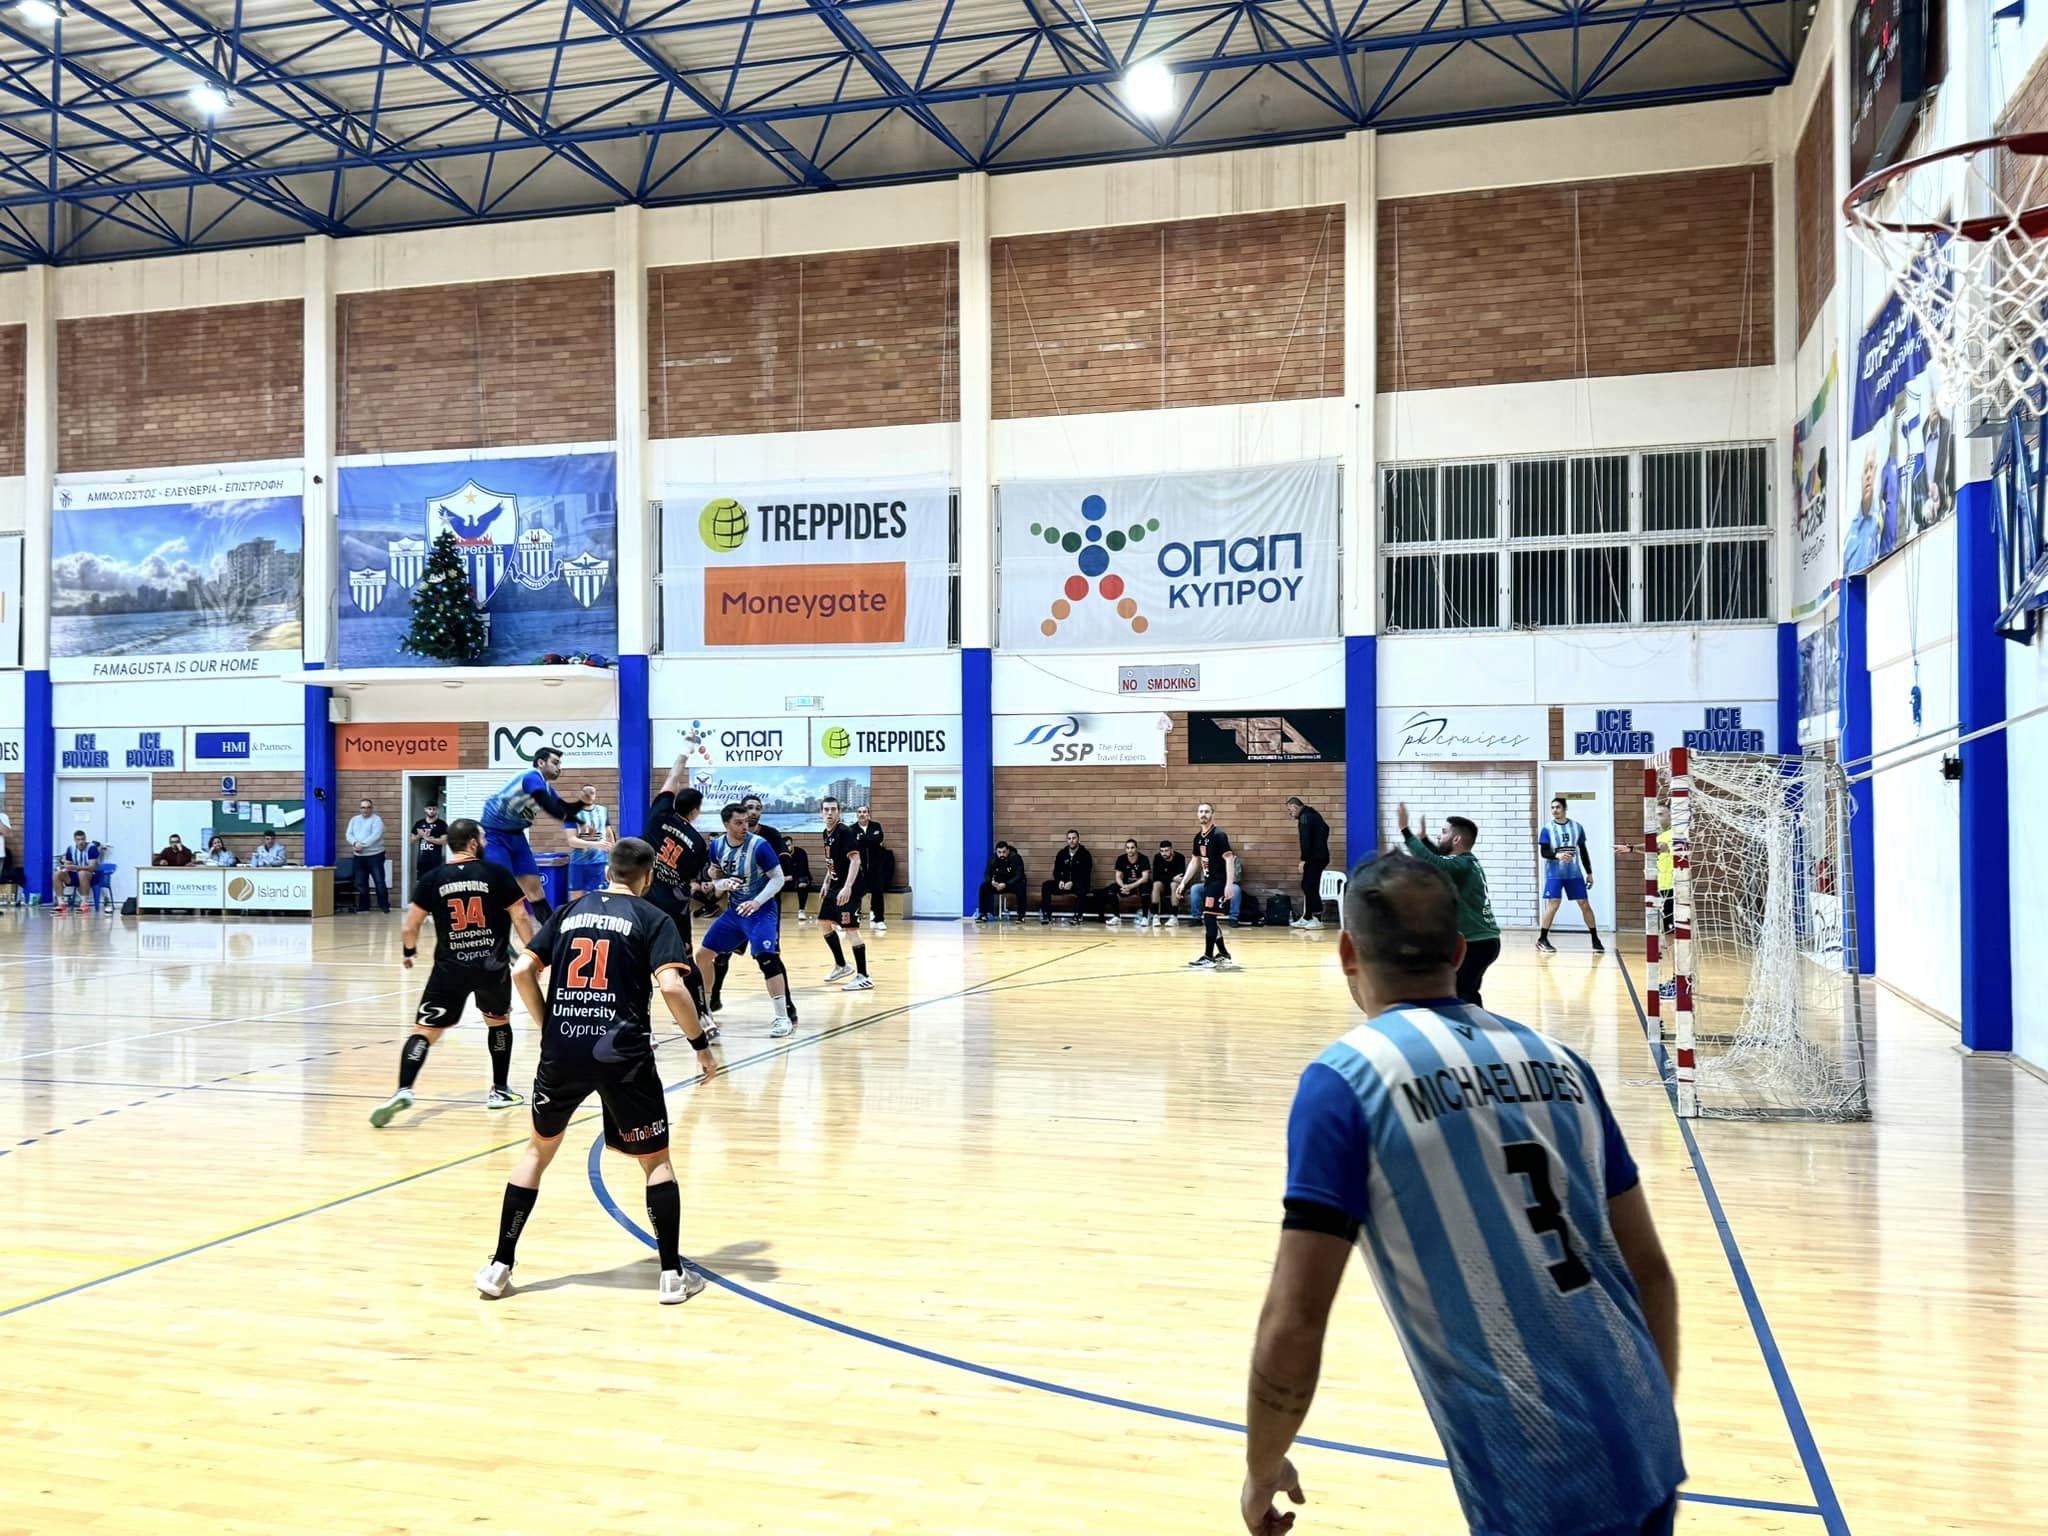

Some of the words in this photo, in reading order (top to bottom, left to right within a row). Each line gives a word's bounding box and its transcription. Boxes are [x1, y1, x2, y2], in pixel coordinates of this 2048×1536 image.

[87, 488, 157, 502] ΑΜΜΟΧΩΣΤΟΣ
[164, 484, 217, 497] ΕΛΕΥΘΕΡΙΑ
[225, 479, 284, 493] ΕΠΙΣΤΡΟΦΗ
[757, 500, 907, 542] TREPPIDES
[1168, 576, 1304, 609] ΚΥΠΡΟΥ
[722, 589, 887, 619] Moneygate
[92, 661, 172, 676] FAMAGUSTA
[175, 661, 186, 673] IS
[190, 660, 218, 673] OUR
[221, 658, 259, 673] HOME
[1122, 679, 1138, 691] NO
[1147, 677, 1197, 690] SMOKING
[1595, 709, 1632, 731] ICE
[1704, 707, 1742, 730] ICE
[75, 733, 96, 750] ICE
[139, 732, 161, 749] ICE
[221, 741, 247, 753] HMI
[260, 742, 293, 753] Partners
[345, 737, 448, 756] Moneygate
[551, 731, 613, 748] COSMA
[856, 730, 946, 753] TREPPIDES
[1575, 731, 1655, 754] POWER
[1682, 729, 1764, 753] POWER
[62, 749, 109, 768] POWER
[126, 748, 175, 768] POWER
[726, 750, 783, 762] ΚΥΠΡΟΥ
[1051, 743, 1094, 761] SSP
[1096, 753, 1118, 761] Travel
[1120, 753, 1147, 762] Experts
[656, 837, 684, 869] 31
[143, 882, 169, 894] HMI
[258, 885, 289, 898] Island
[293, 885, 307, 898] Oil
[447, 896, 486, 931] 34
[449, 928, 492, 941] European
[449, 937, 495, 951] University
[456, 949, 490, 962] Cyprus
[567, 937, 610, 989] 21
[556, 988, 616, 1003] European
[552, 1004, 616, 1021] University
[560, 1022, 607, 1038] Cyprus
[1401, 1061, 1584, 1123] MICHAELIDES
[1504, 1140, 1590, 1293] 3
